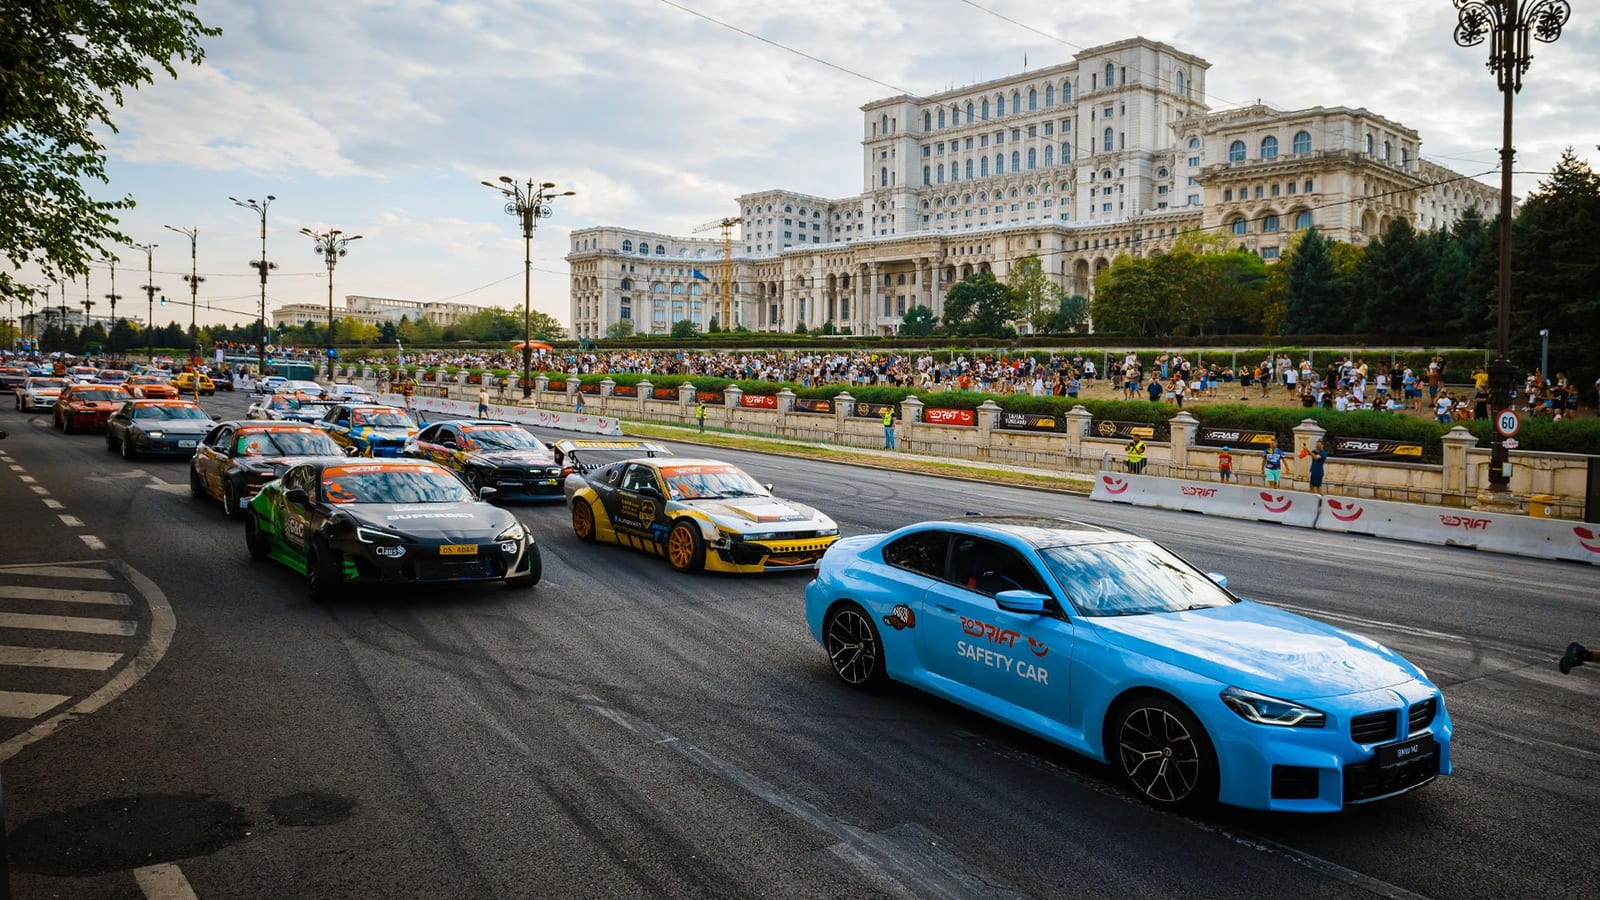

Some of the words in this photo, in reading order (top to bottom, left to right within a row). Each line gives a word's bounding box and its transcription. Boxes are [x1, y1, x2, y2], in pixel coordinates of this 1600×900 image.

[1501, 416, 1515, 430] 60
[1344, 441, 1380, 451] FRAS
[957, 640, 1014, 673] SAFETY
[1016, 660, 1049, 686] CAR
